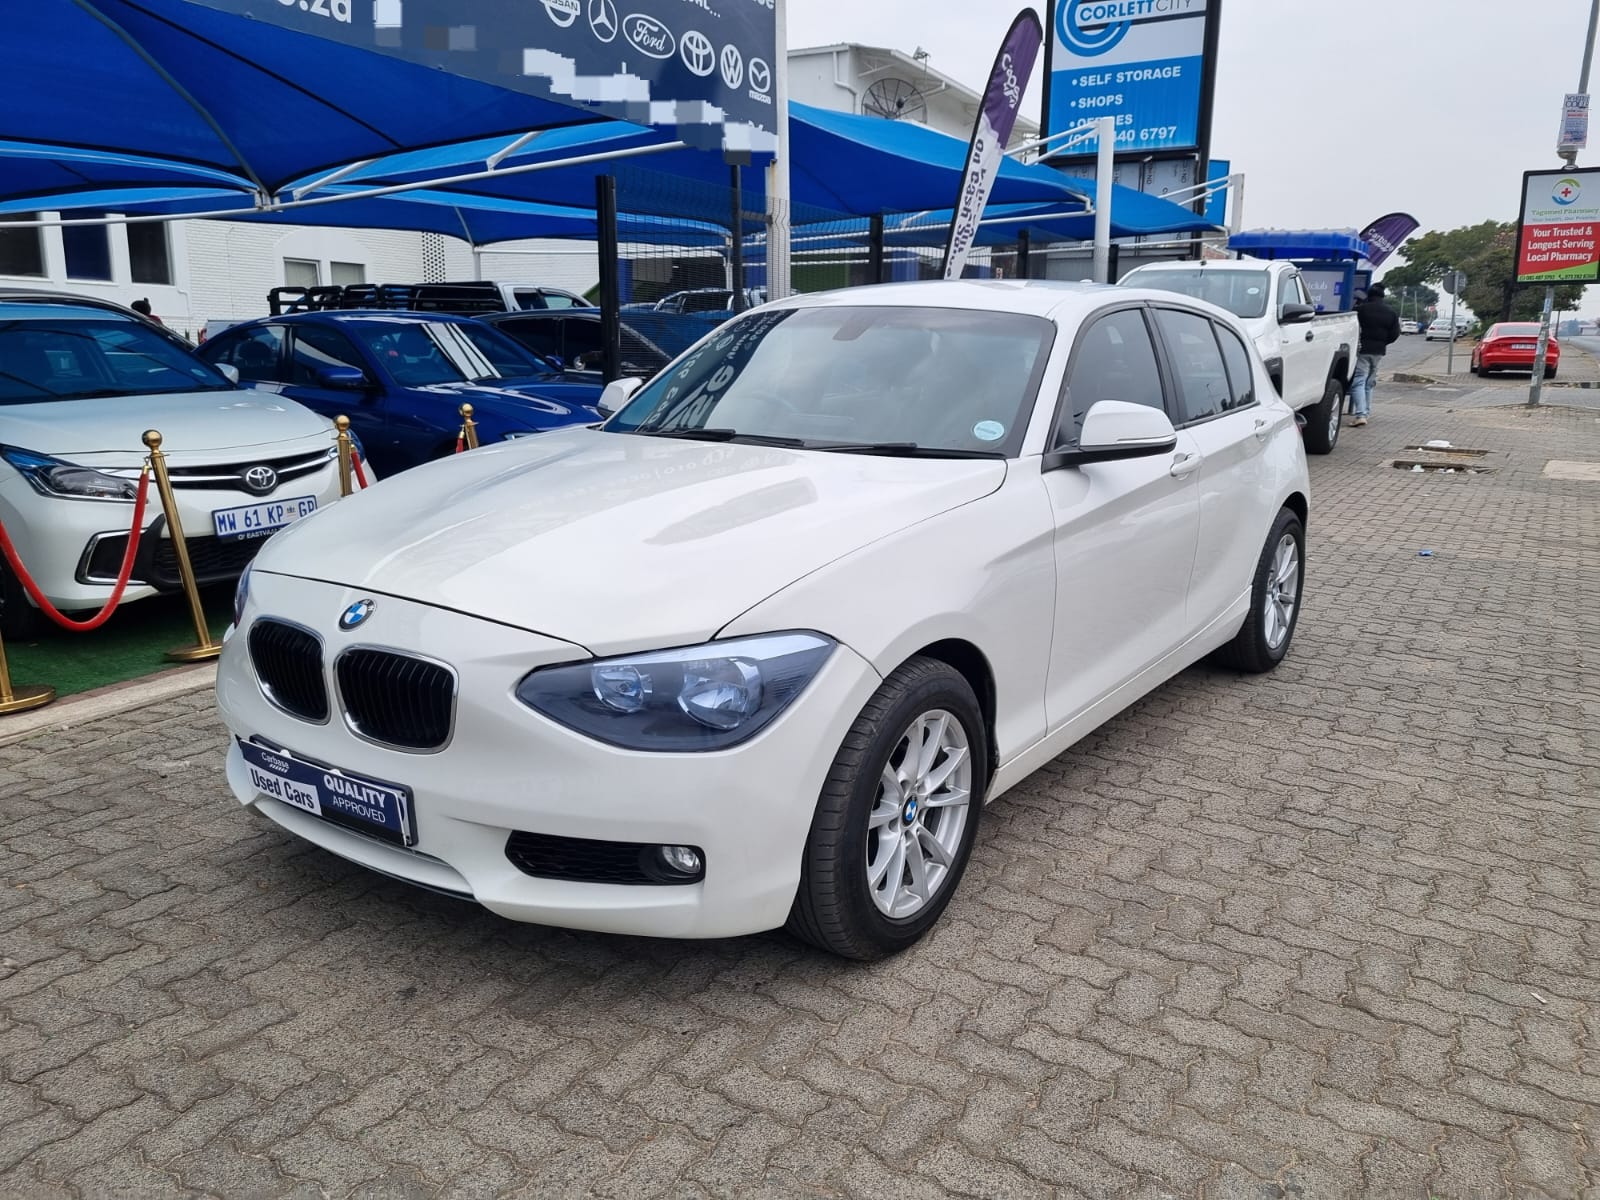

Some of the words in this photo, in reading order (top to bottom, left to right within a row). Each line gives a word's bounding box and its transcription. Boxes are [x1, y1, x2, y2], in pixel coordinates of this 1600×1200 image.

[1079, 0, 1153, 22] CORLETT
[633, 19, 667, 52] Ford
[1079, 73, 1113, 87] SELF
[1116, 65, 1182, 83] STORAGE
[1077, 94, 1123, 109] SHOPS
[1140, 125, 1177, 140] 6797
[1532, 228, 1551, 237] Your
[1552, 226, 1584, 237] Trusted
[1585, 226, 1593, 236] &
[1527, 240, 1561, 251] Longest
[1562, 239, 1595, 249] Serving
[1527, 252, 1550, 262] Local
[1550, 252, 1592, 262] Pharmacy
[216, 512, 237, 533] MW
[244, 509, 262, 528] 61
[267, 504, 284, 524] KP
[260, 751, 290, 770] Carbase
[250, 767, 282, 797] Used
[283, 781, 315, 810] Cars
[323, 774, 386, 809] QUALITY
[332, 795, 386, 823] APPROVED
